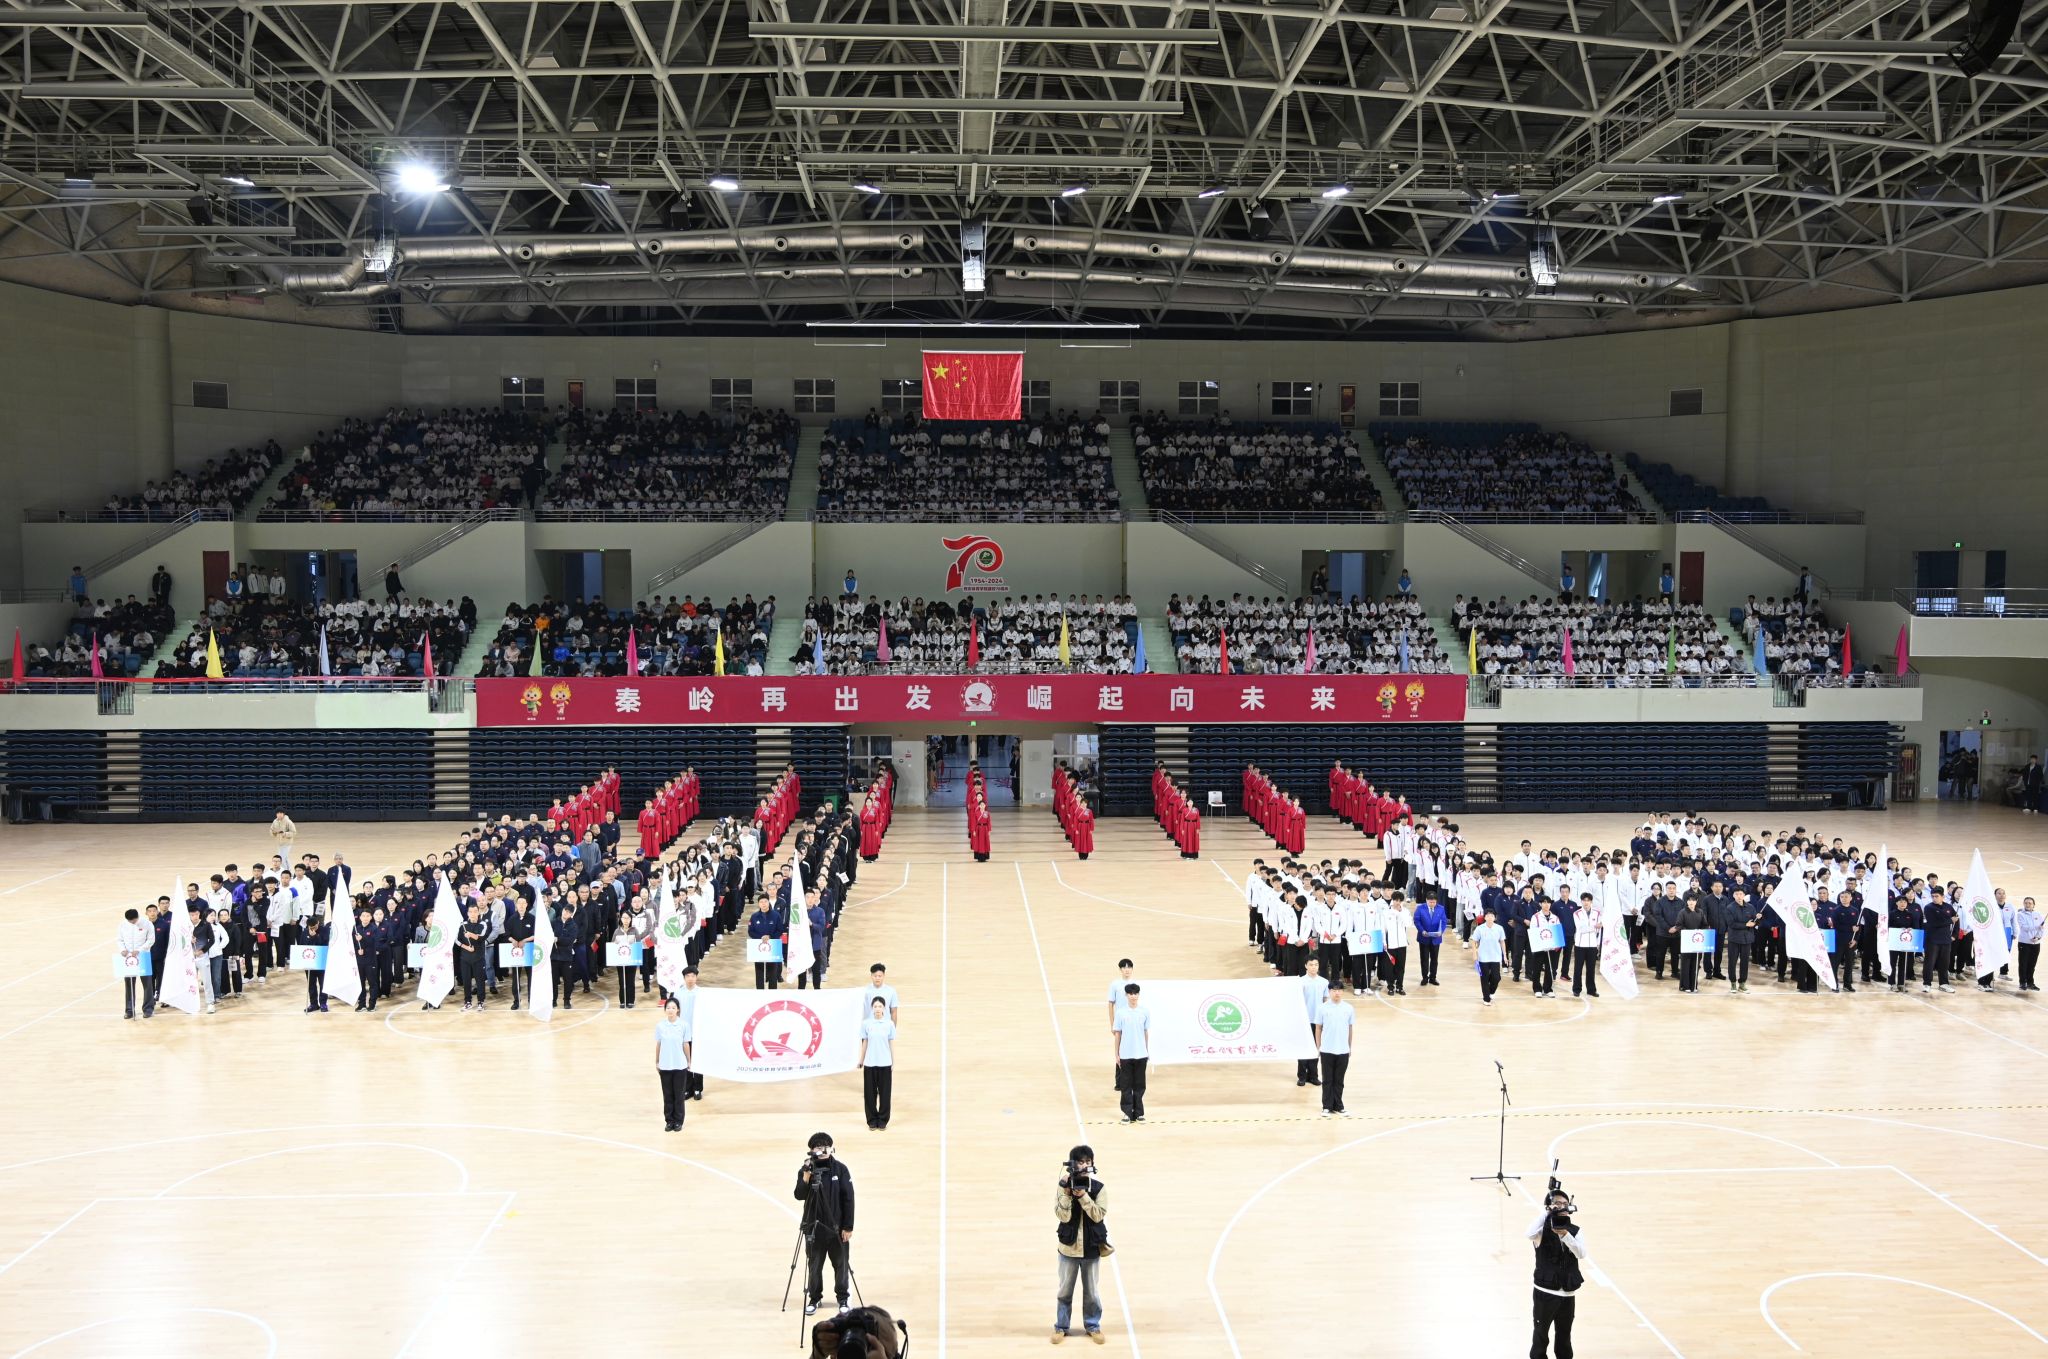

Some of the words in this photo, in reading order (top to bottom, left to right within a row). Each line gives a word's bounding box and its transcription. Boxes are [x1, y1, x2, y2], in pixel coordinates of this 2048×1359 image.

[970, 577, 1004, 585] 1954-2024
[614, 685, 931, 712] 秦岭再出发
[1027, 684, 1335, 711] 崛起向未来
